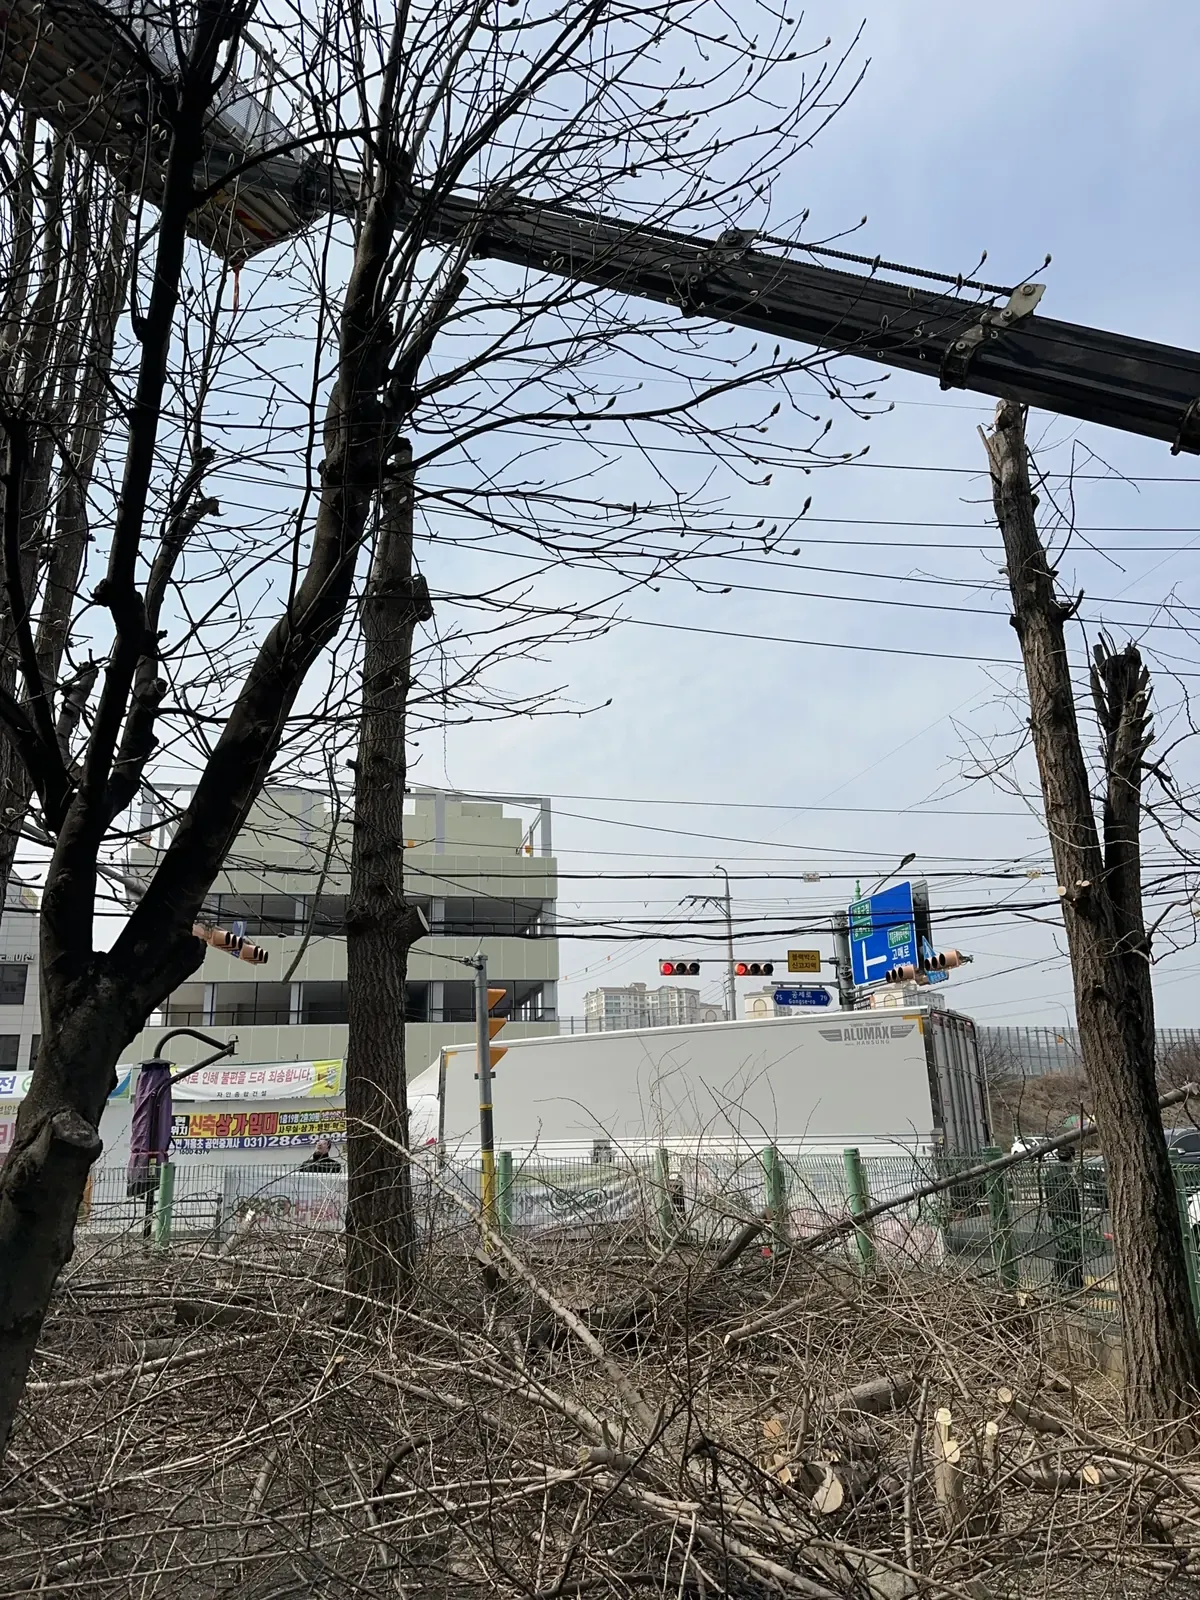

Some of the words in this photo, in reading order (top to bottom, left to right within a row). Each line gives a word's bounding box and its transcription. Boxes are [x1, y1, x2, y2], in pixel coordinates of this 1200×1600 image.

[792, 953, 816, 961] 블랙박스
[844, 1026, 889, 1041] ALUMAX
[202, 1072, 219, 1084] 인해
[221, 1071, 246, 1085] 불편을
[249, 1071, 265, 1083] 드려
[268, 1068, 312, 1083] 죄송합니다.
[175, 1116, 186, 1126] 현
[171, 1126, 188, 1135] 위치
[205, 1137, 240, 1148] 공인중개사
